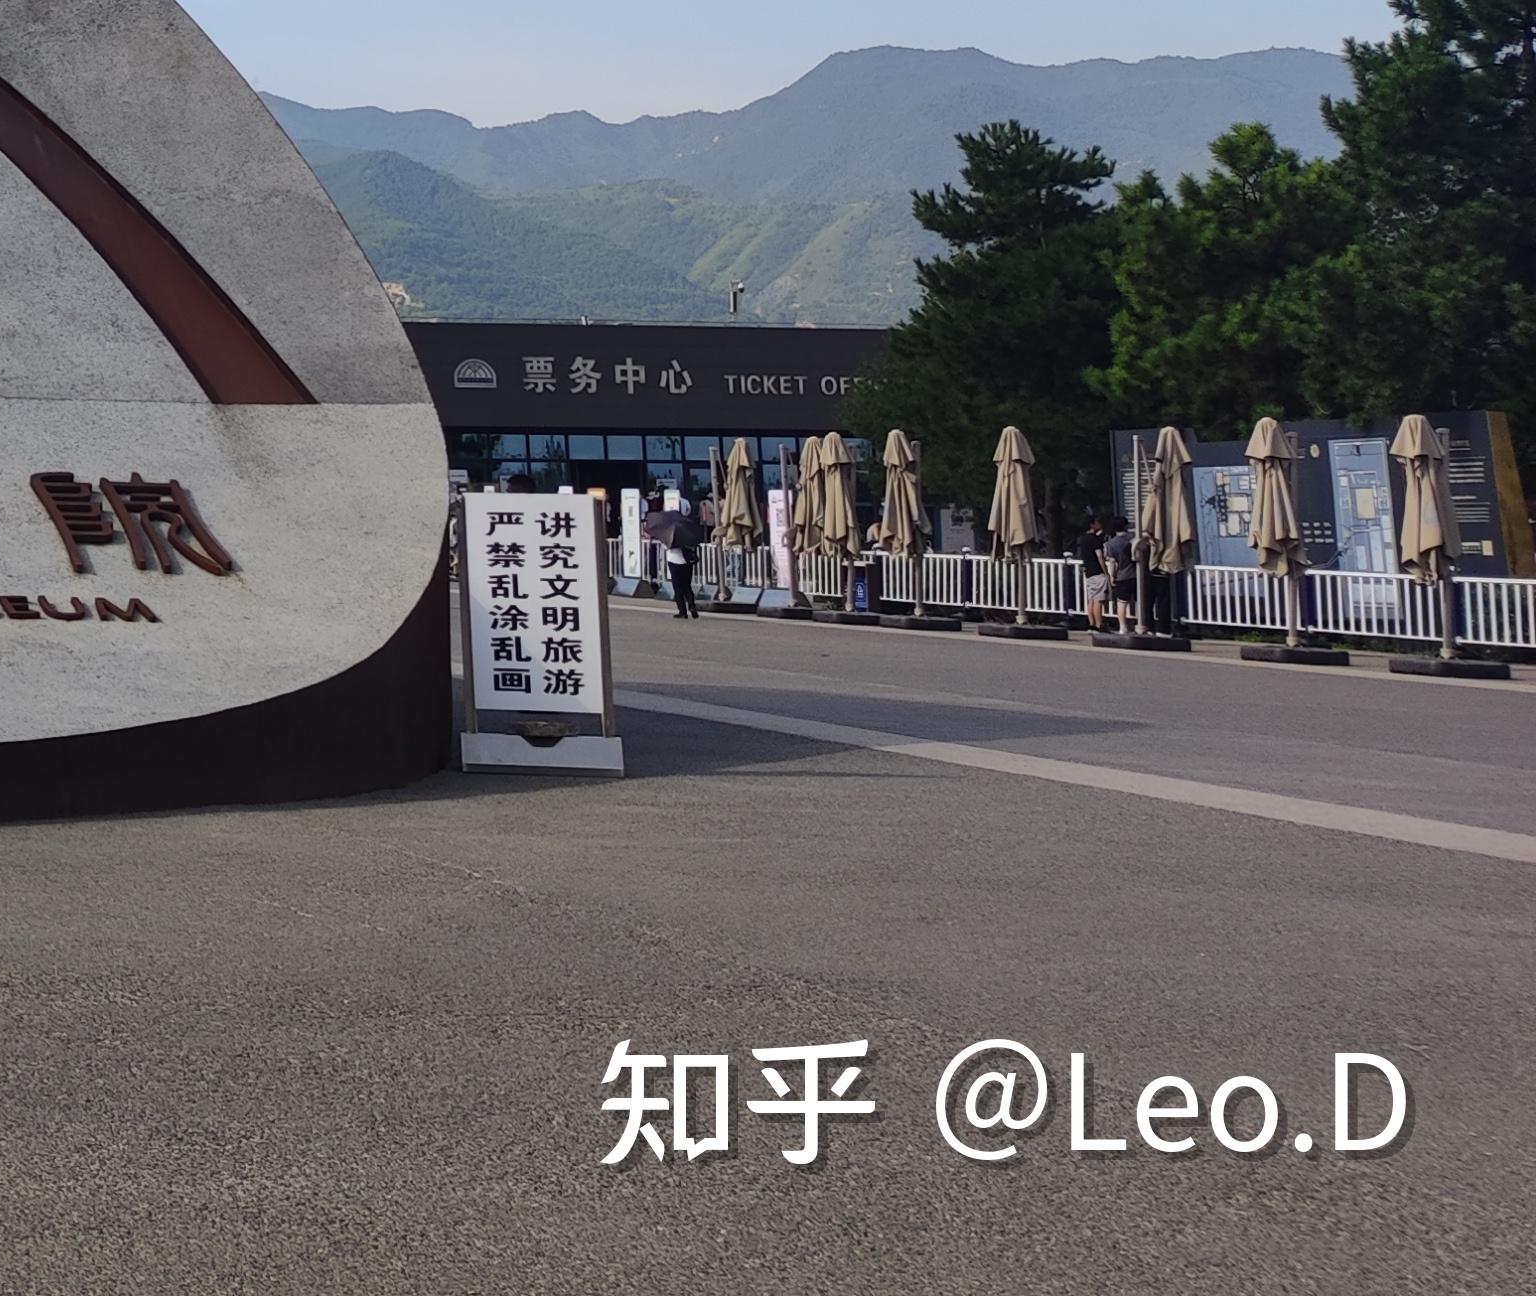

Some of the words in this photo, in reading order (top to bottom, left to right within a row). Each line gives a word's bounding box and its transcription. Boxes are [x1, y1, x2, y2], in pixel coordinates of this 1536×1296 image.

[521, 355, 693, 396] 票务中心
[724, 374, 808, 396] TICKET
[485, 511, 532, 694] 严禁乱涂乱画
[534, 511, 585, 696] 讲究文明旅游
